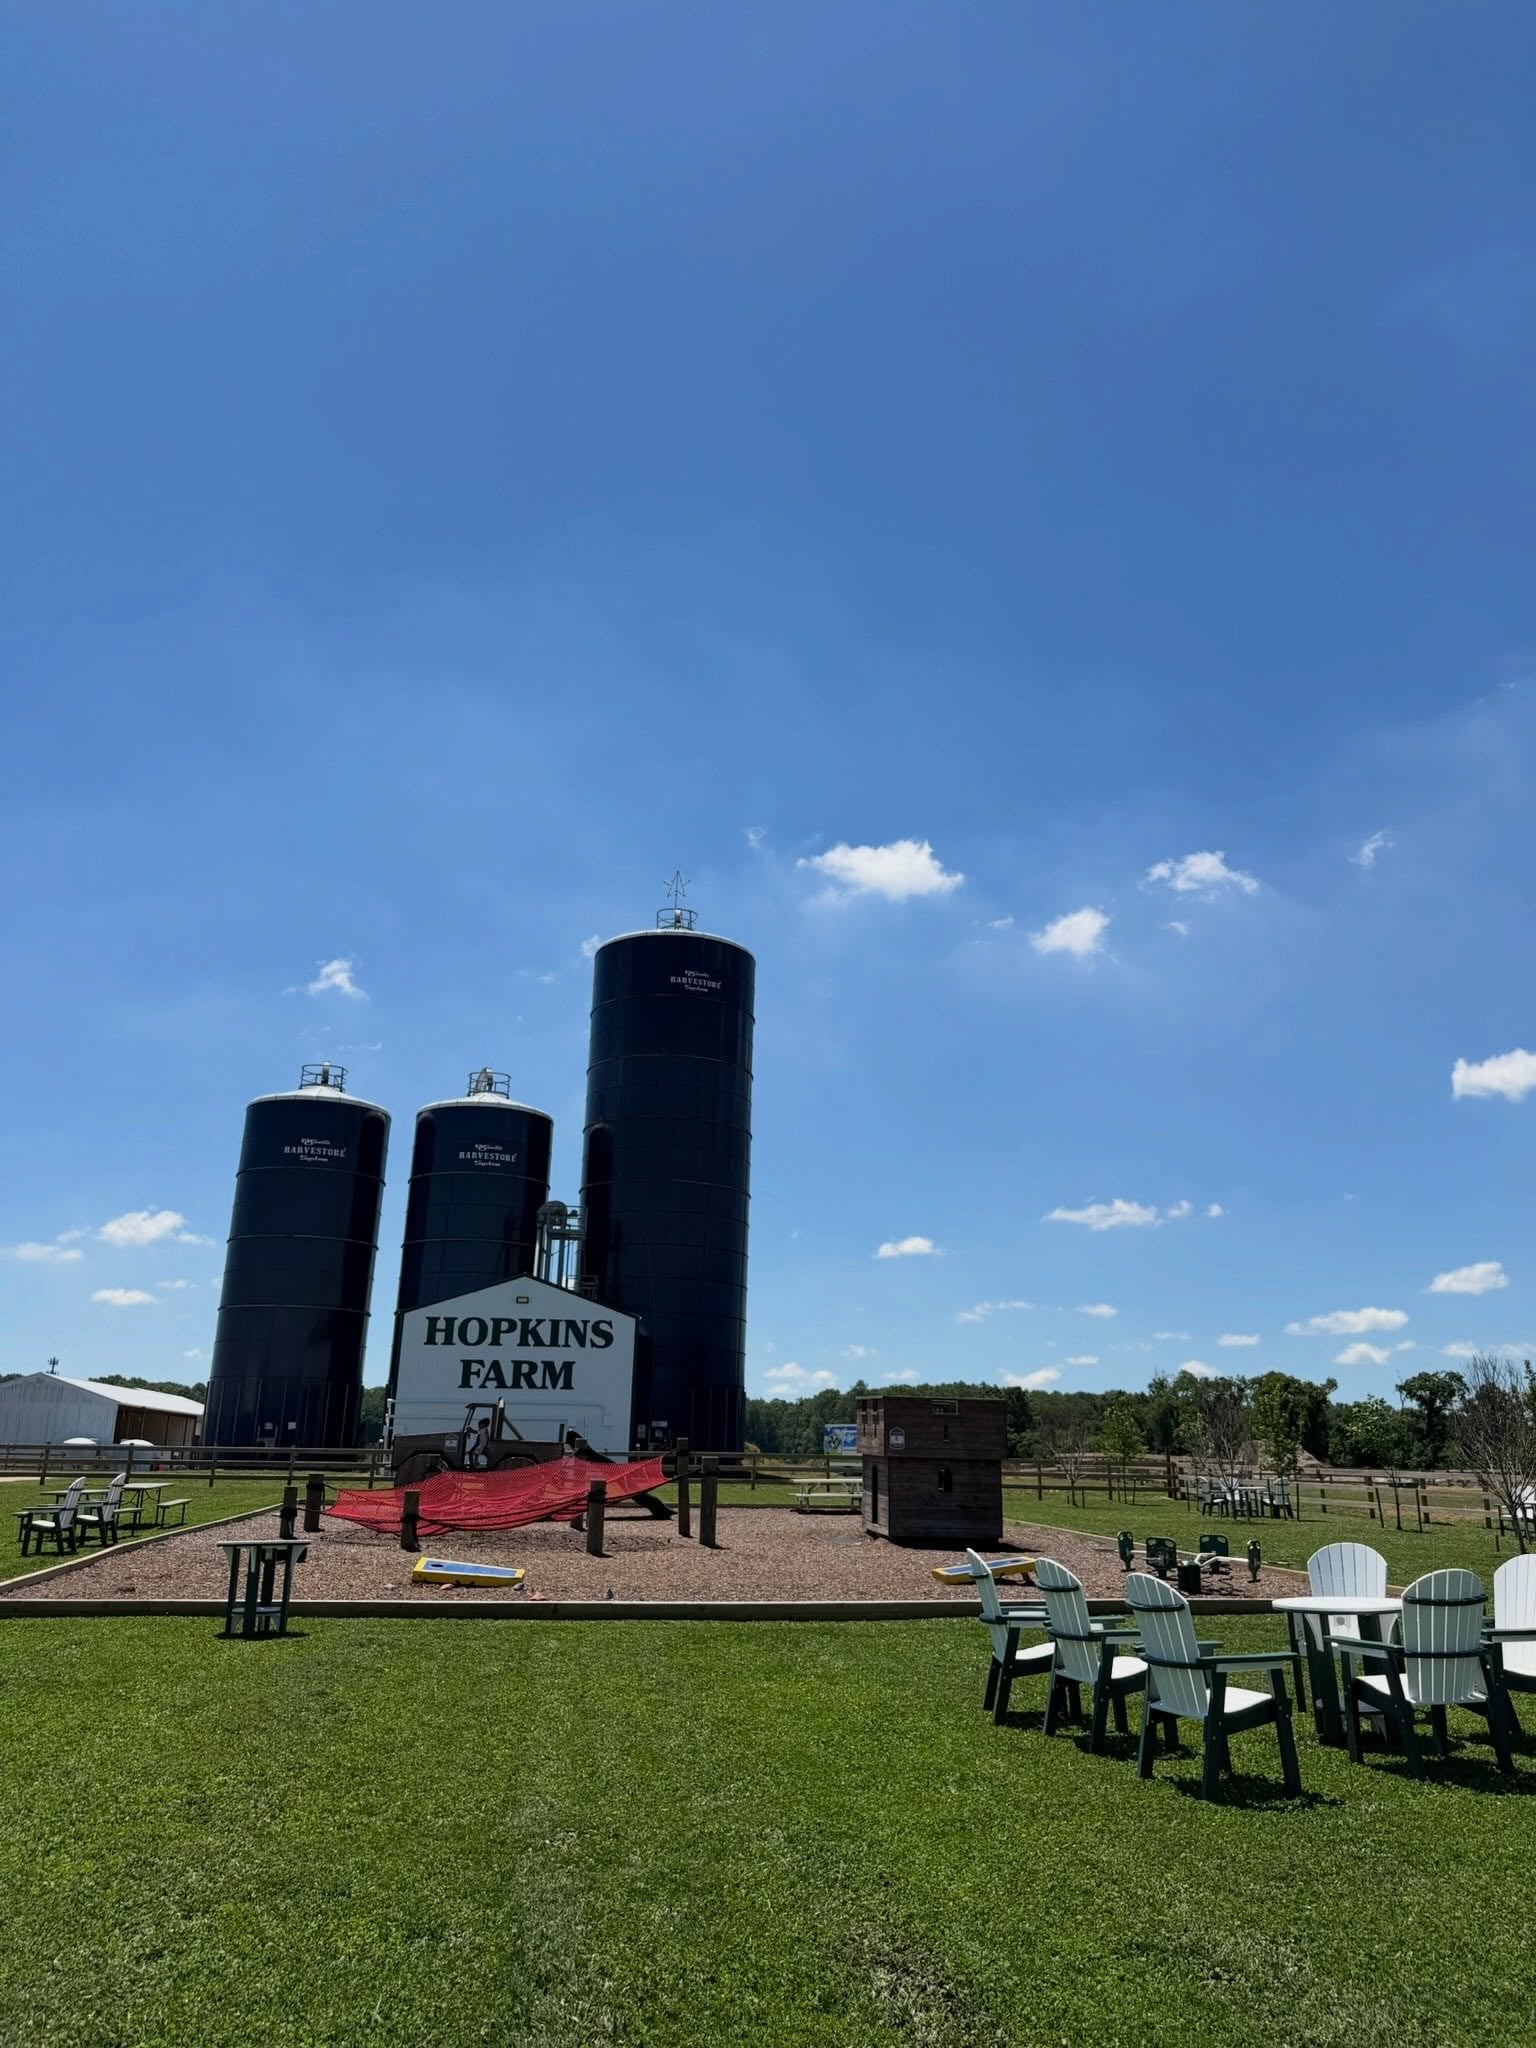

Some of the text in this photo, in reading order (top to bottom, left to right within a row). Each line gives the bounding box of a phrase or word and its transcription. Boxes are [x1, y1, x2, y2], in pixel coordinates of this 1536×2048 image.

[670, 976, 721, 990] HARVESTORE
[284, 1146, 346, 1158] HARVESTORE
[459, 1151, 517, 1163] HARVESTORE
[423, 1316, 614, 1349] HOPKINS
[458, 1359, 576, 1390] FARM
